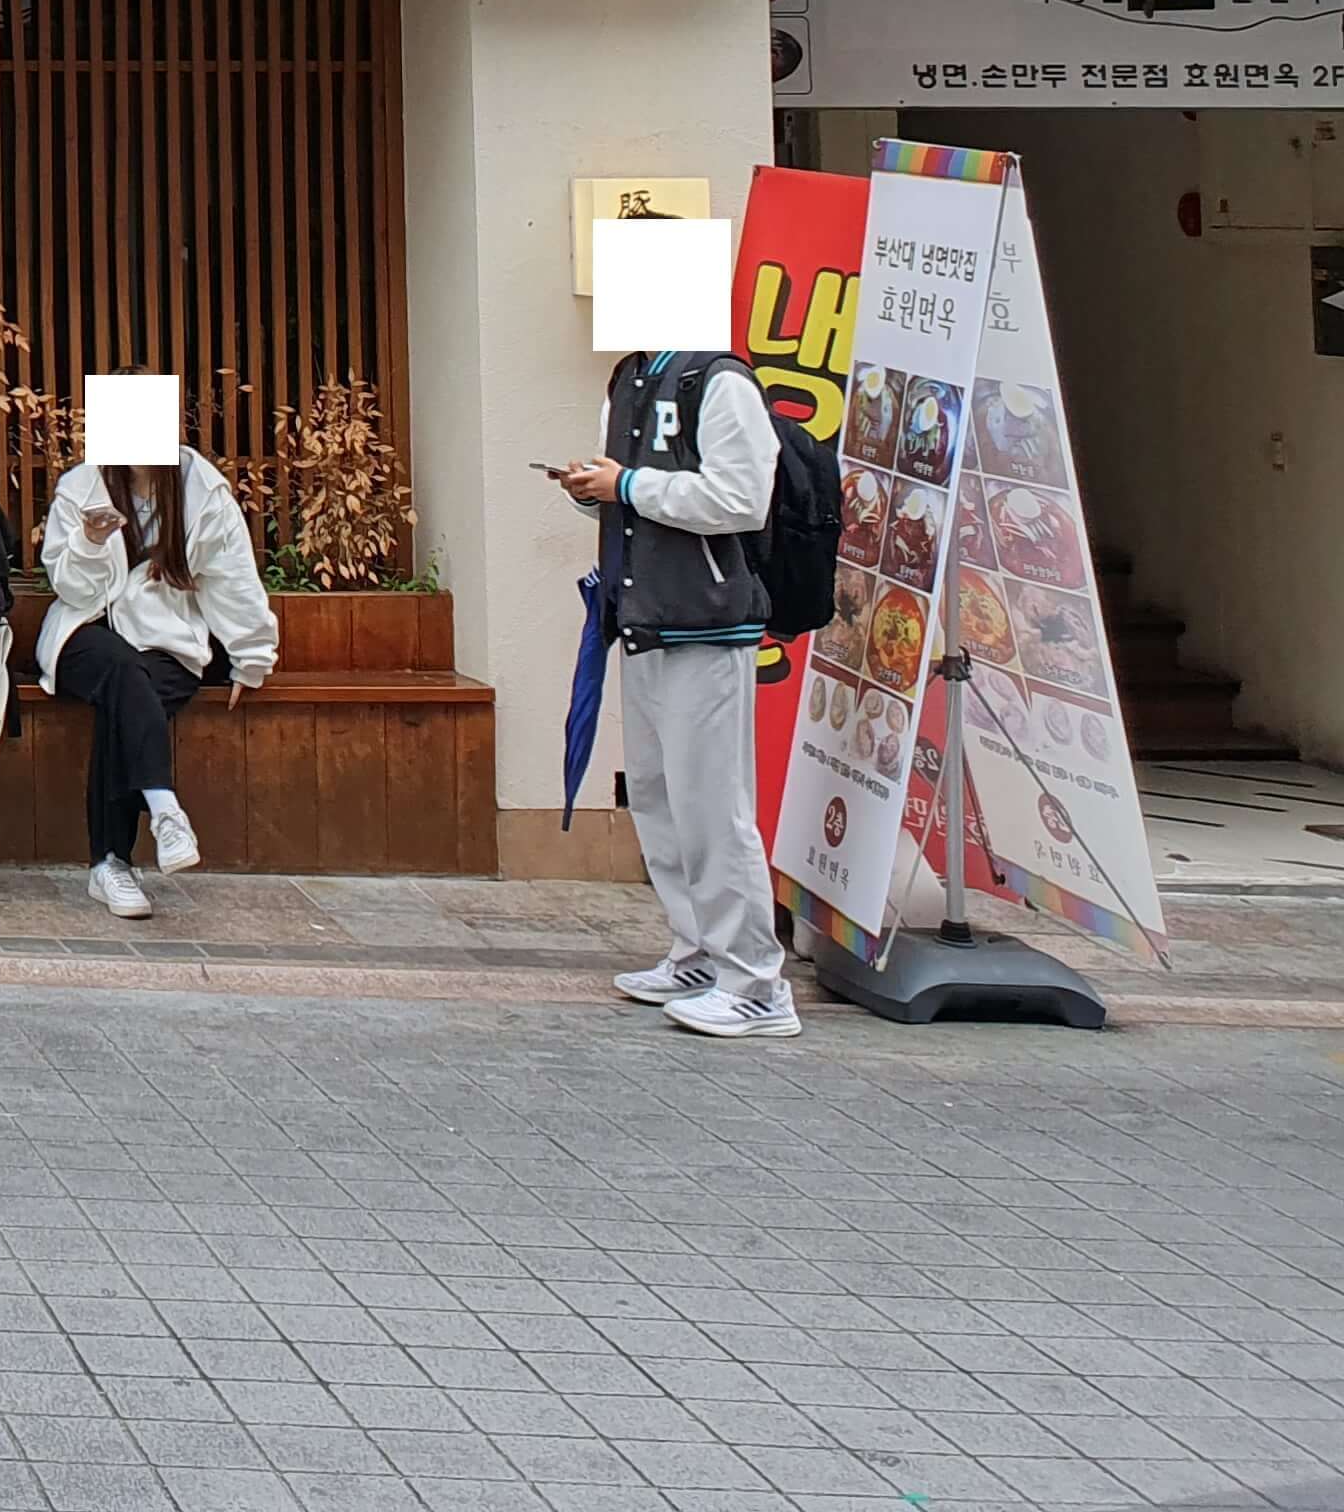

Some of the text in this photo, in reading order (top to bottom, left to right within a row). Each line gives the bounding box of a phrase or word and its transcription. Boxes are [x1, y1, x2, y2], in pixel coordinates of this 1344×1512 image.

[1080, 63, 1169, 89] 전문점
[1183, 62, 1300, 89] 효원면옥
[874, 237, 978, 283] 부산대 냉면맛집
[877, 285, 957, 342] 효원면옥
[652, 399, 682, 452] P
